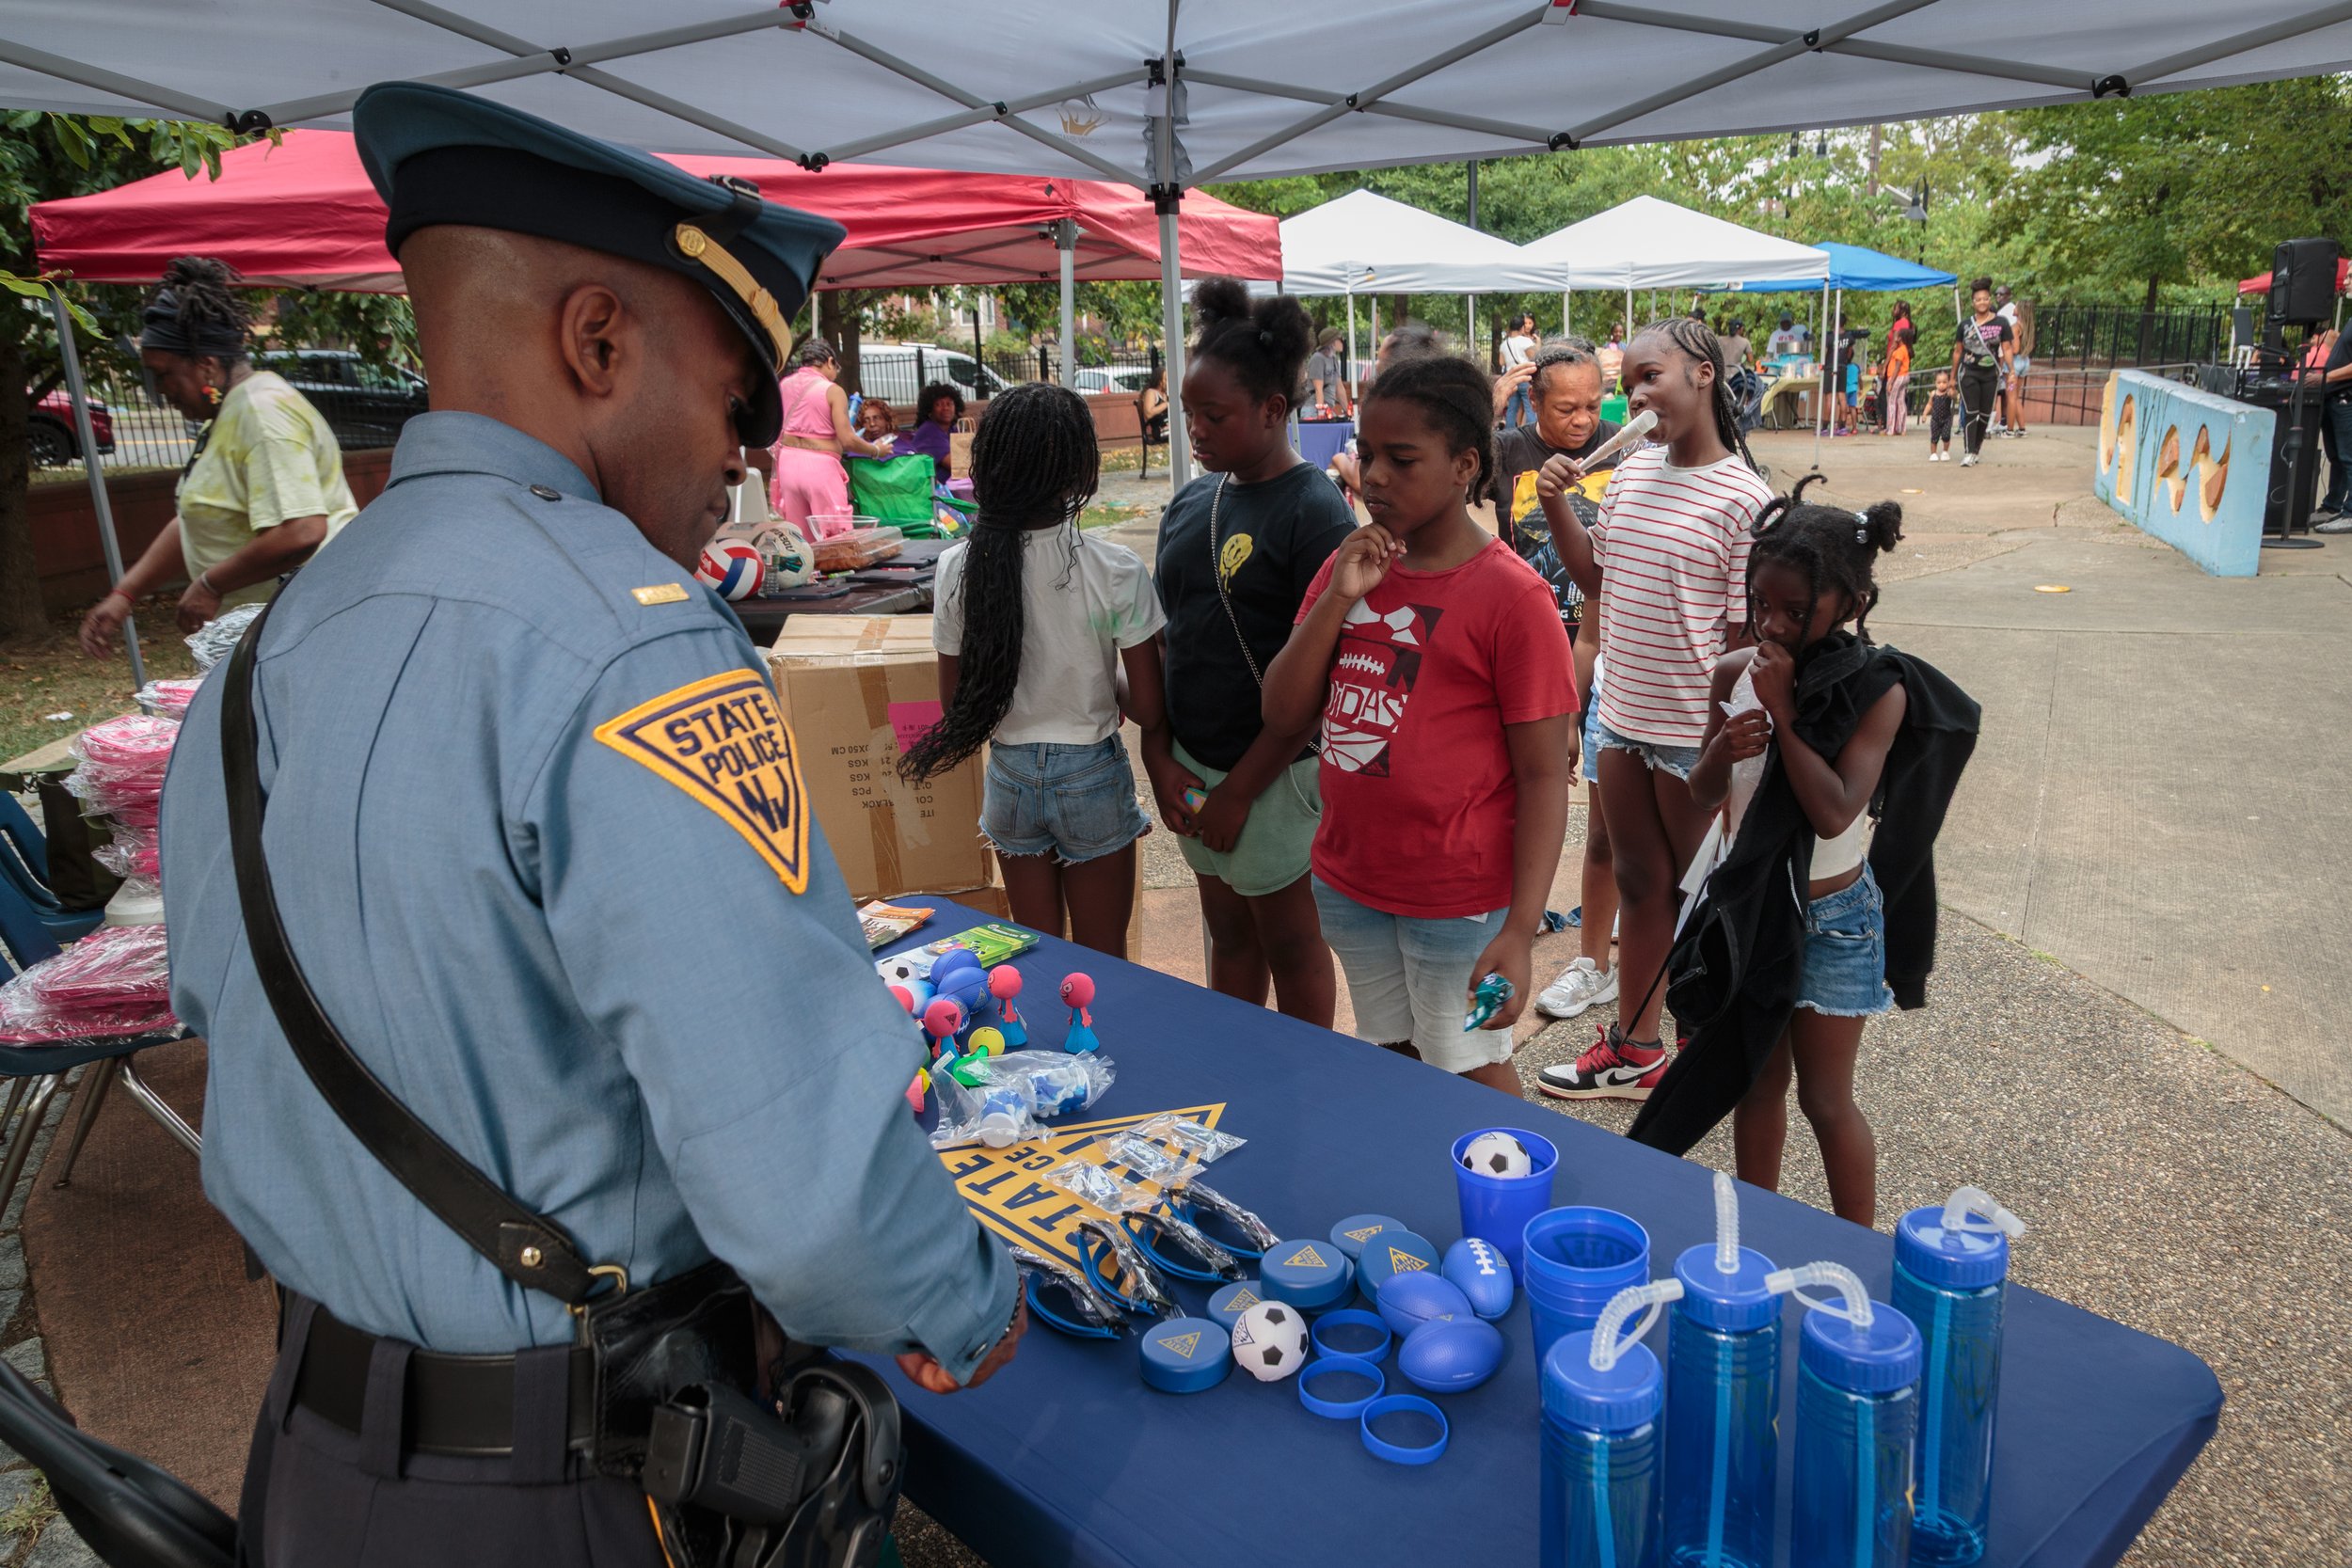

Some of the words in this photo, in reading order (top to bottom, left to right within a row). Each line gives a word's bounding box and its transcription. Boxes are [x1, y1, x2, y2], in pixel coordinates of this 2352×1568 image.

[664, 694, 777, 757] STATE
[832, 746, 846, 755] CM
[702, 730, 788, 784] POLICE
[848, 759, 868, 768] KGS
[850, 773, 870, 782] KGS
[851, 787, 871, 796] PCS
[736, 766, 790, 833] NJ
